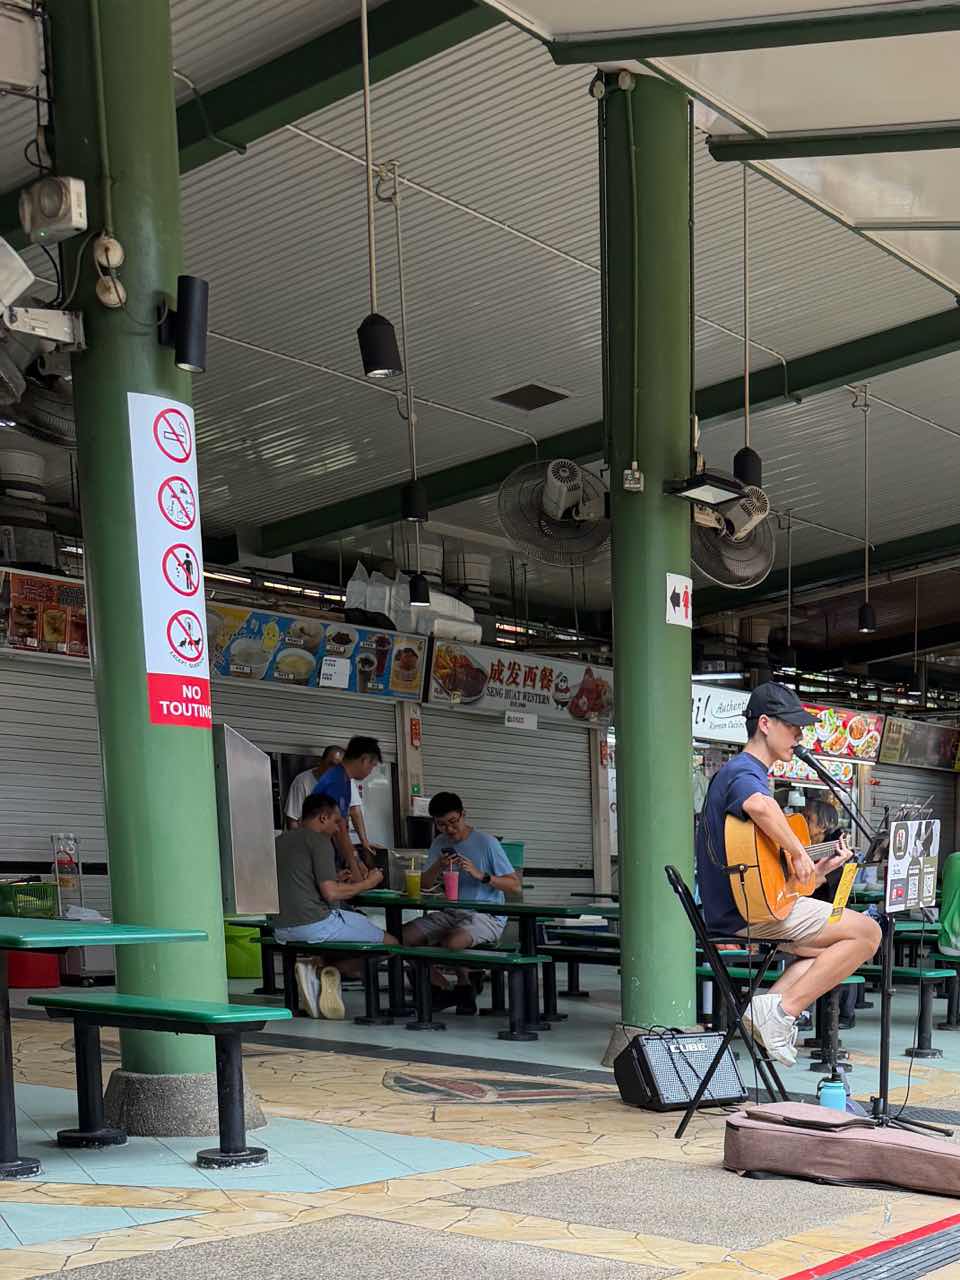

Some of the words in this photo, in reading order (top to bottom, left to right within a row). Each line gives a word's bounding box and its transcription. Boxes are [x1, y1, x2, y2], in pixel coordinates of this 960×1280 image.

[182, 684, 202, 700] NO
[486, 685, 504, 698] SENG
[521, 691, 552, 705] WESTERN
[159, 700, 212, 719] TOUTING
[716, 698, 747, 714] Authenti
[669, 1043, 708, 1053] CUBE
